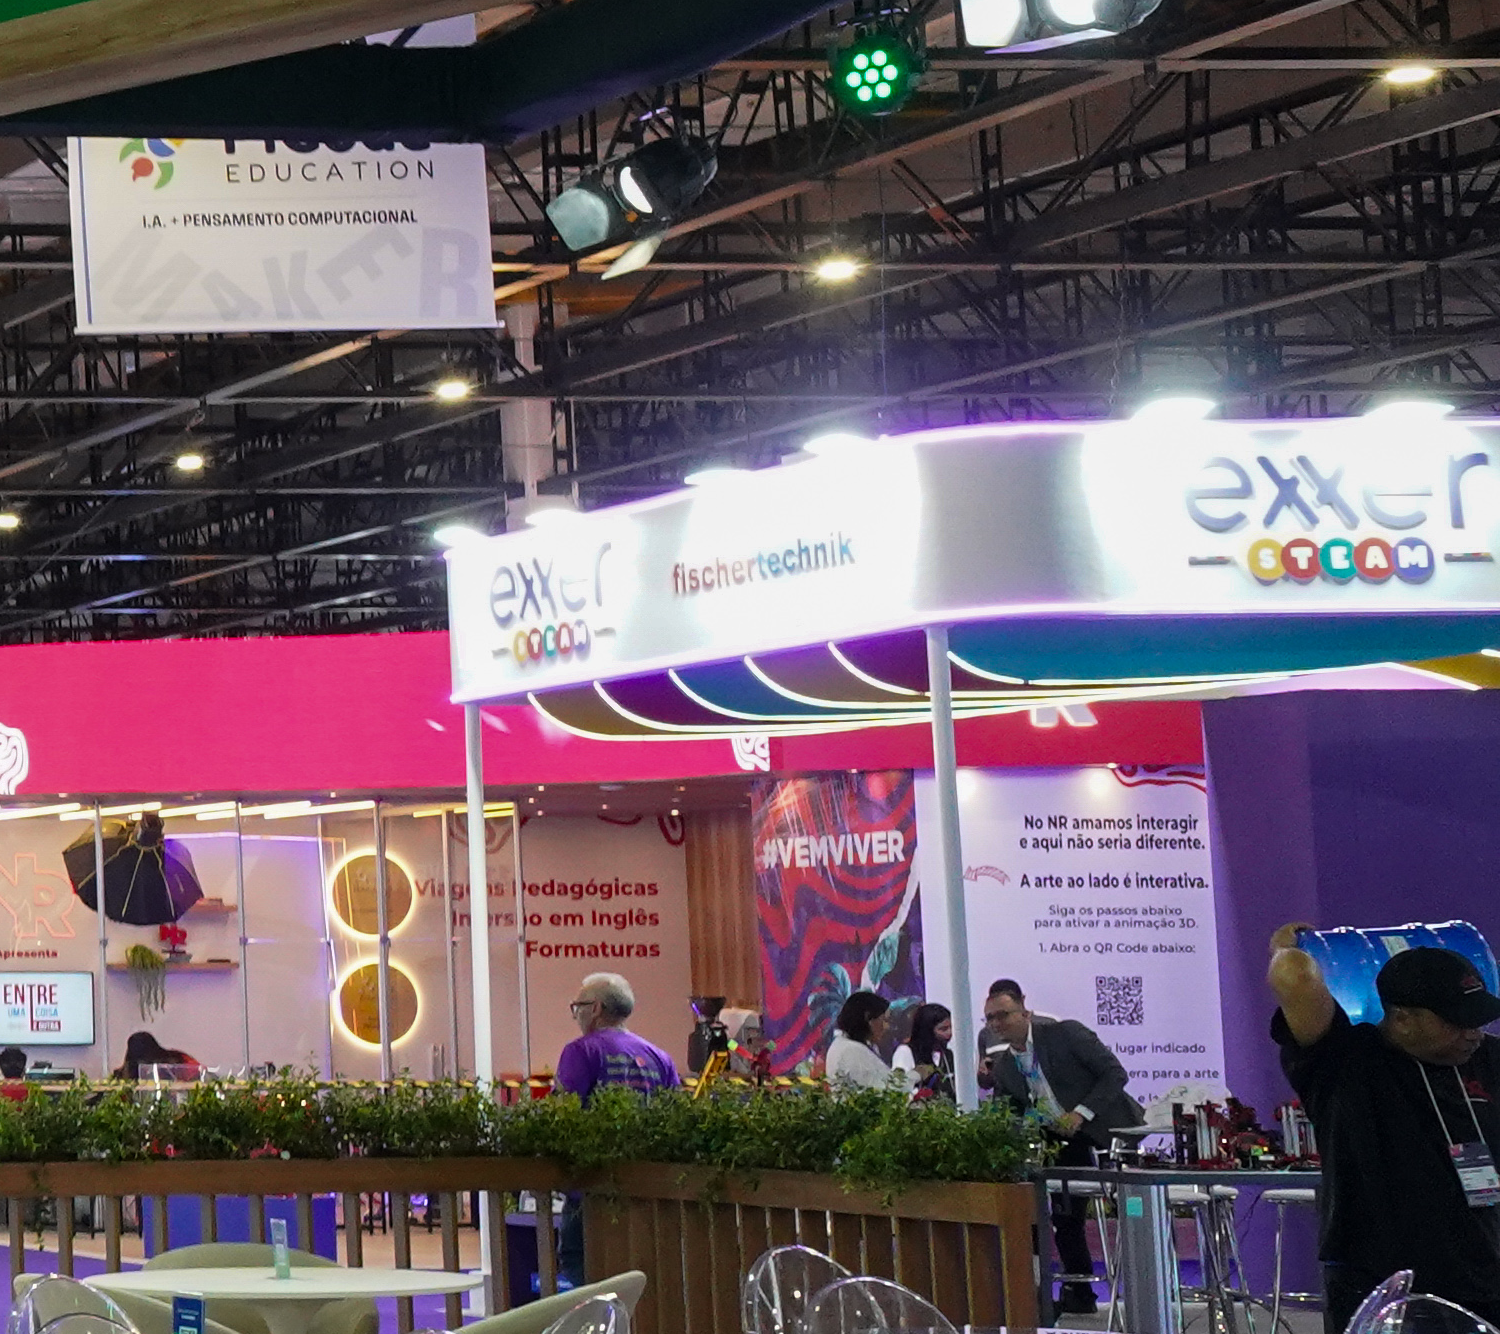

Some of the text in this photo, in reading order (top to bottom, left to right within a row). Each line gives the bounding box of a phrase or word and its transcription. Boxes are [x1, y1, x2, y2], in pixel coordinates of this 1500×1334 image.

[225, 159, 435, 183] EDUCATION
[142, 214, 166, 228] I.A.
[182, 212, 285, 228] PENSAMENTO
[288, 209, 419, 226] COMPUTACIONAL
[672, 532, 856, 595] fischertechnik
[1252, 539, 1432, 577] STEAM
[1024, 814, 1198, 834] No NR amamos interagir
[762, 830, 905, 869] #VEMVIVER
[1019, 833, 1206, 853] e aqui não seria diferente.
[1020, 872, 1209, 888] A arte ao lado é interativa.
[549, 913, 583, 927] em
[591, 908, 660, 930] Inglês
[1049, 905, 1182, 918] Siga os passos abaixo
[1034, 919, 1062, 930] para
[1065, 918, 1100, 929] ativar
[1103, 920, 1111, 929] a
[1114, 918, 1176, 931] animação
[525, 938, 661, 958] Formaturas
[1038, 942, 1196, 955] 1. Abra o QR Code abaixo:
[3, 983, 58, 1005] ENTRE
[1115, 1042, 1148, 1056] lugar
[1151, 1042, 1206, 1054] indicado
[1152, 1069, 1180, 1081] para
[1183, 1070, 1191, 1079] a
[1194, 1069, 1219, 1079] arte
